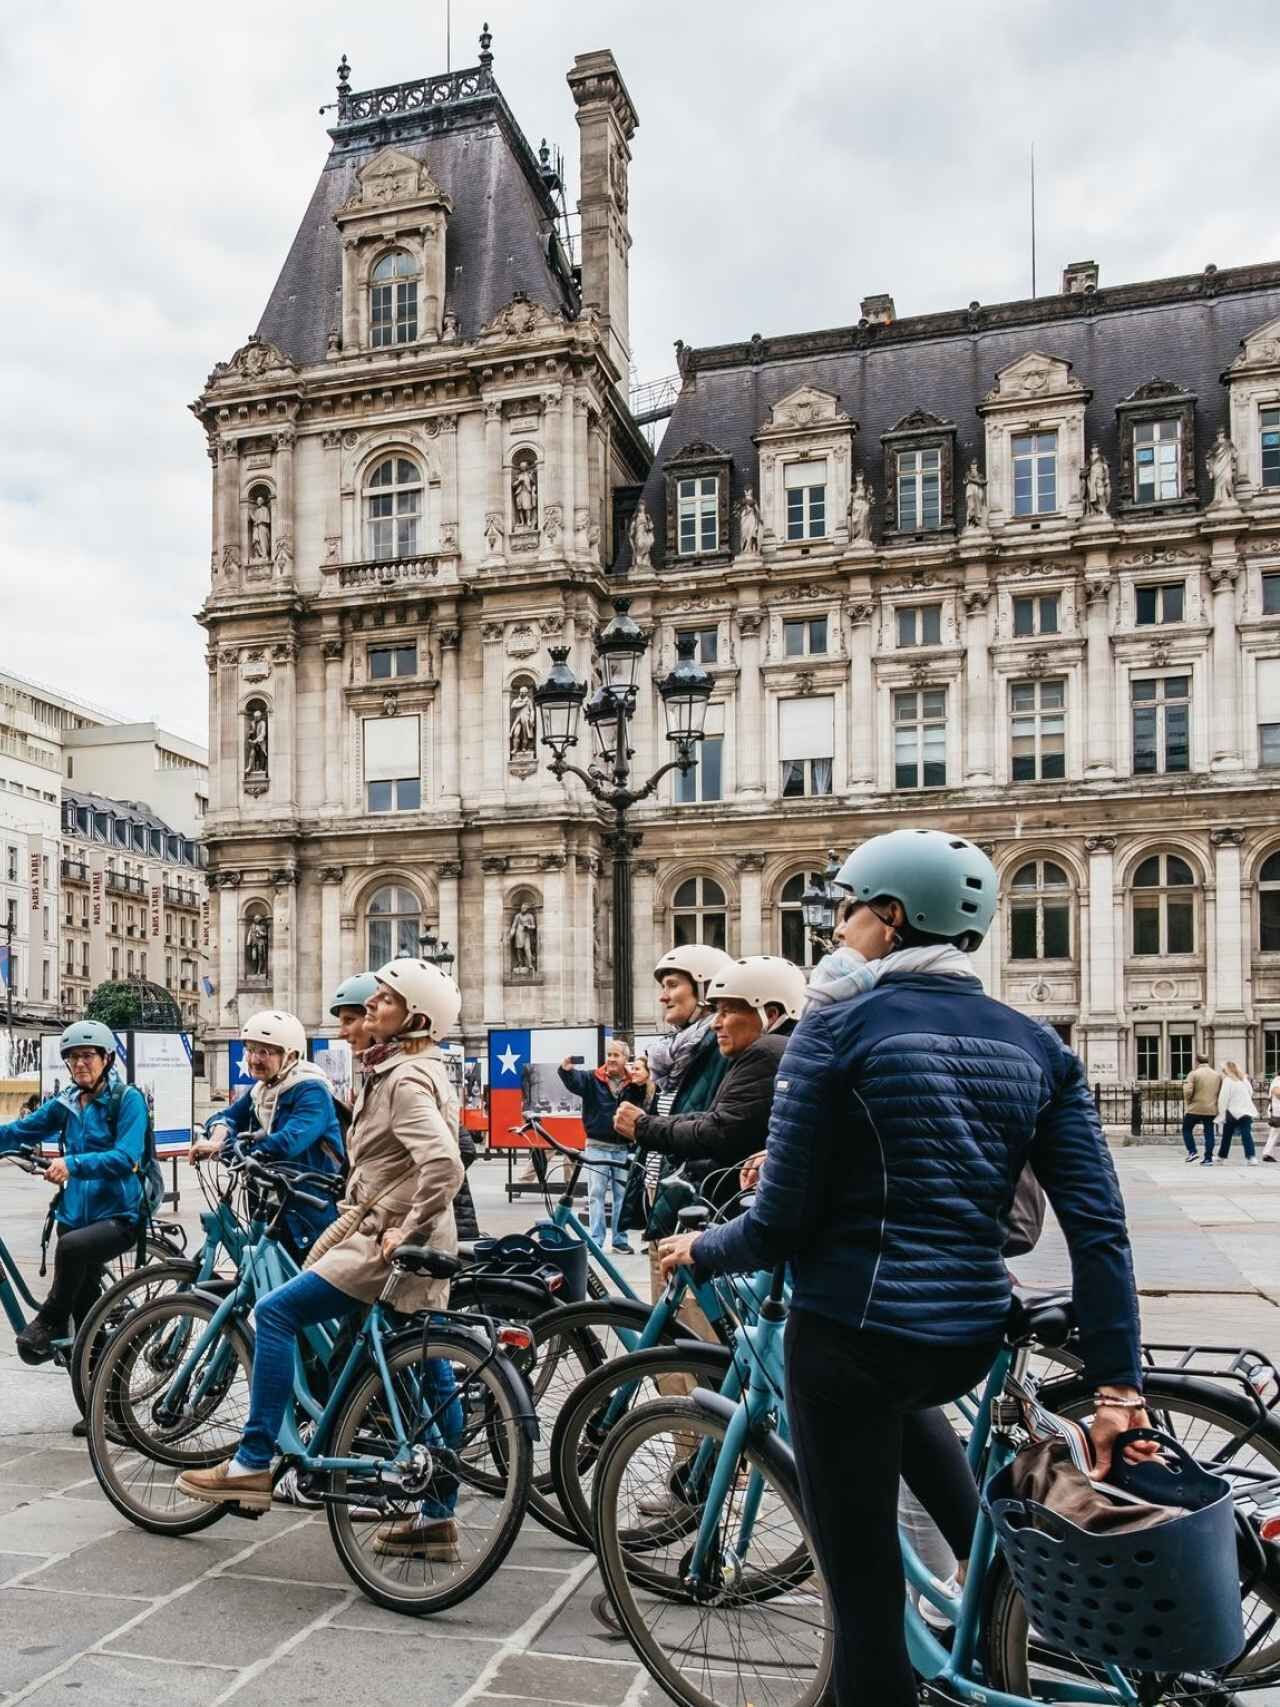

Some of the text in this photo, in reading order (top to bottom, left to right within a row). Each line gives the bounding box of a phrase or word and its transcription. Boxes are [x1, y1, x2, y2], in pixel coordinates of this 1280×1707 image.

[31, 853, 39, 878] TABLE
[92, 871, 100, 894] TABLE
[31, 887, 40, 911] PARIS
[151, 886, 159, 908] TABLE
[93, 903, 101, 925] PARIS
[152, 915, 160, 937] PARIS
